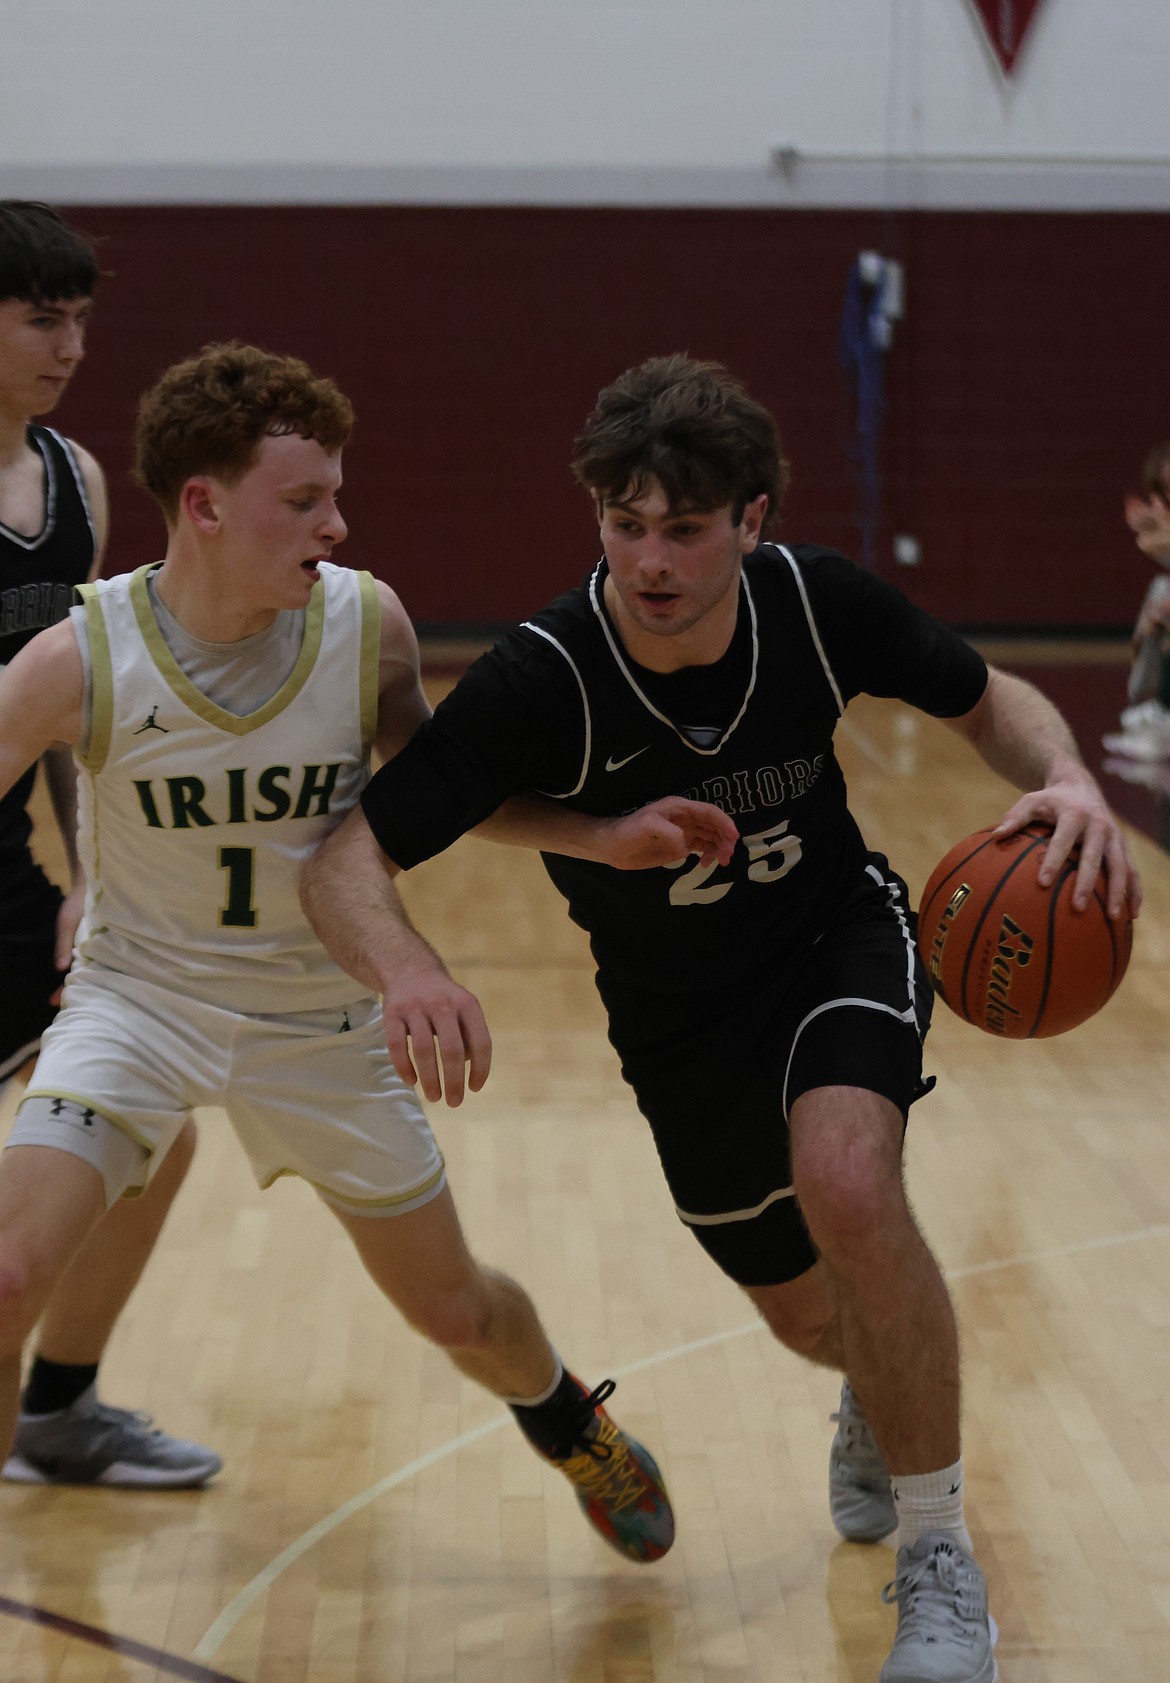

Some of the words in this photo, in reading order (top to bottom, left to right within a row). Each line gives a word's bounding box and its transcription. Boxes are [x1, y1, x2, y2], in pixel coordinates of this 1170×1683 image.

[133, 763, 342, 829] IRISH
[217, 845, 259, 928] 1
[662, 819, 803, 906] 25
[985, 913, 1034, 1034] Baden
